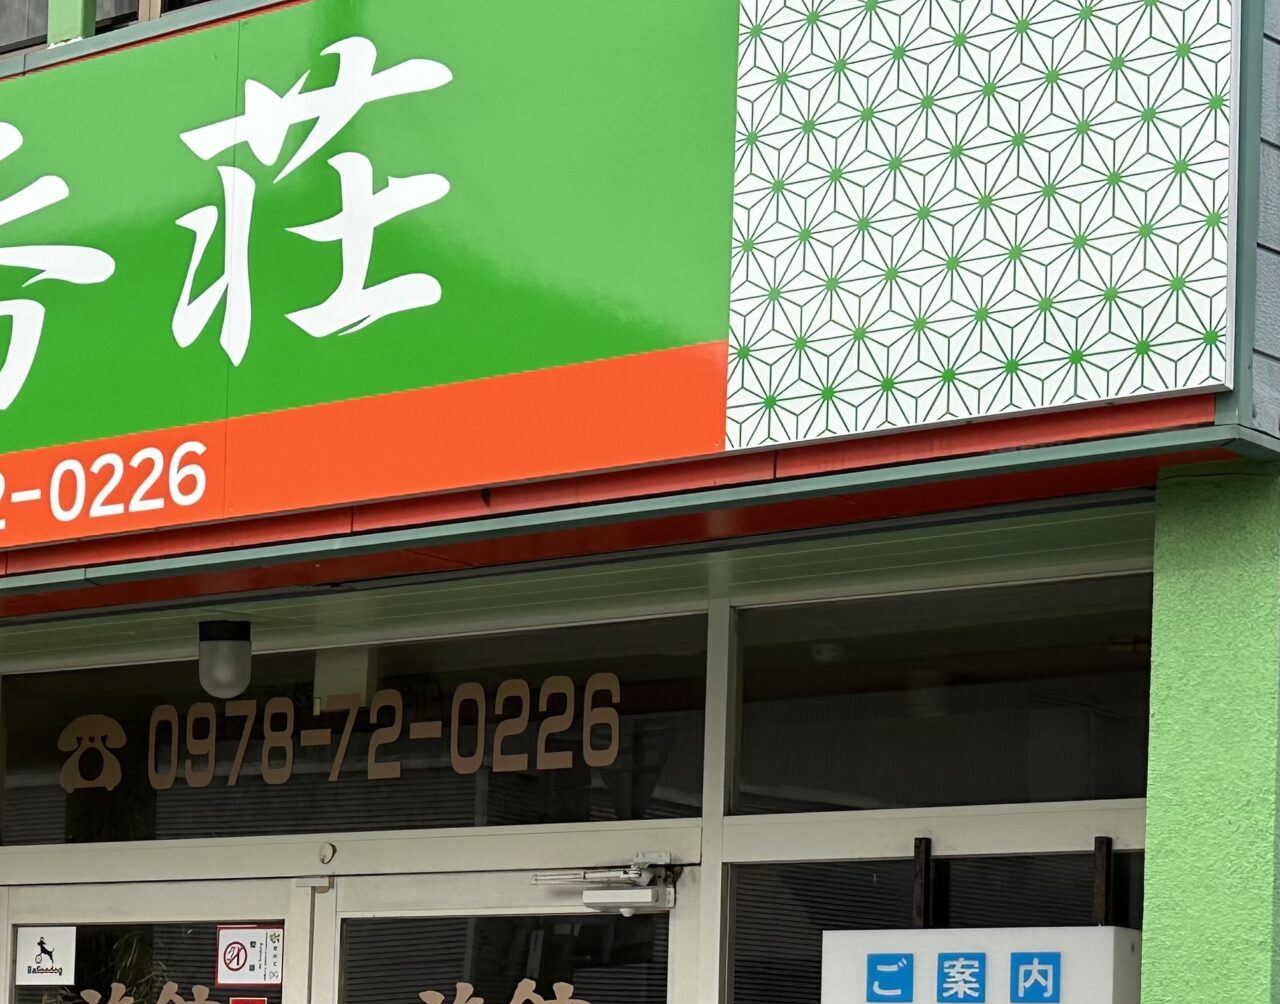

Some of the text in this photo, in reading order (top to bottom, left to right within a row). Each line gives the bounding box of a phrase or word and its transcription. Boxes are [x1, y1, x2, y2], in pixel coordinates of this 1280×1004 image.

[148, 672, 621, 790] 0978-72-0226
[872, 957, 1054, 999] ご案内
